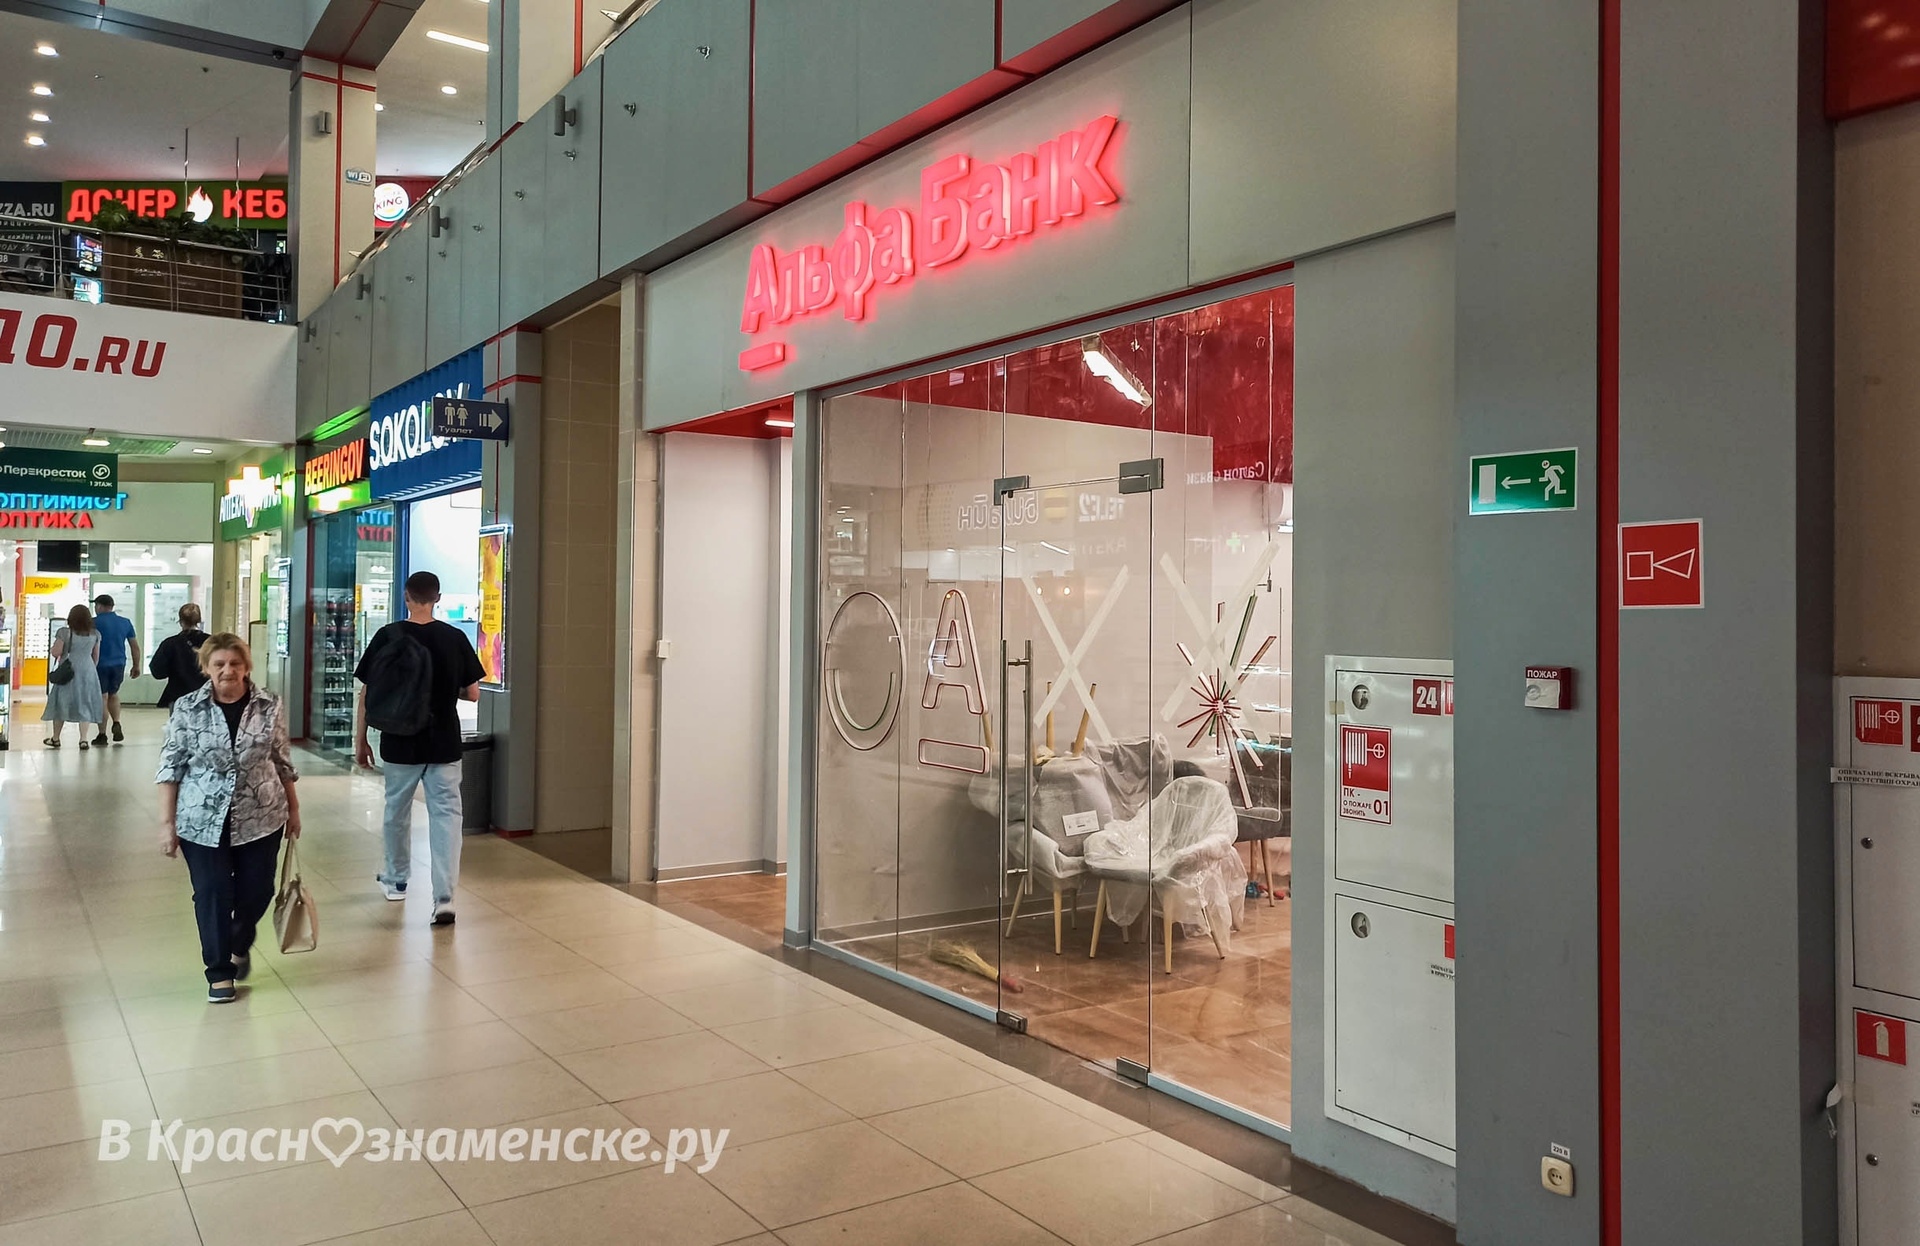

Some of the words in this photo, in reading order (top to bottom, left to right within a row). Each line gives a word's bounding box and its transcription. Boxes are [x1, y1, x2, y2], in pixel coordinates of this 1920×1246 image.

[376, 197, 402, 210] KING
[740, 201, 914, 333] Альфа
[920, 114, 1118, 268] Банк
[369, 382, 466, 471] SOKOL
[438, 425, 474, 434] Туалет
[4, 464, 87, 479] Перекресток
[304, 437, 364, 496] BEERINGOV
[1527, 669, 1558, 679] ПОЖАР
[1416, 685, 1438, 709] 24
[1343, 787, 1355, 798] ПК
[1343, 807, 1366, 817] ЗВОНИТЬ
[1349, 800, 1372, 810] ПОЖАРЕ
[1373, 799, 1388, 816] 01
